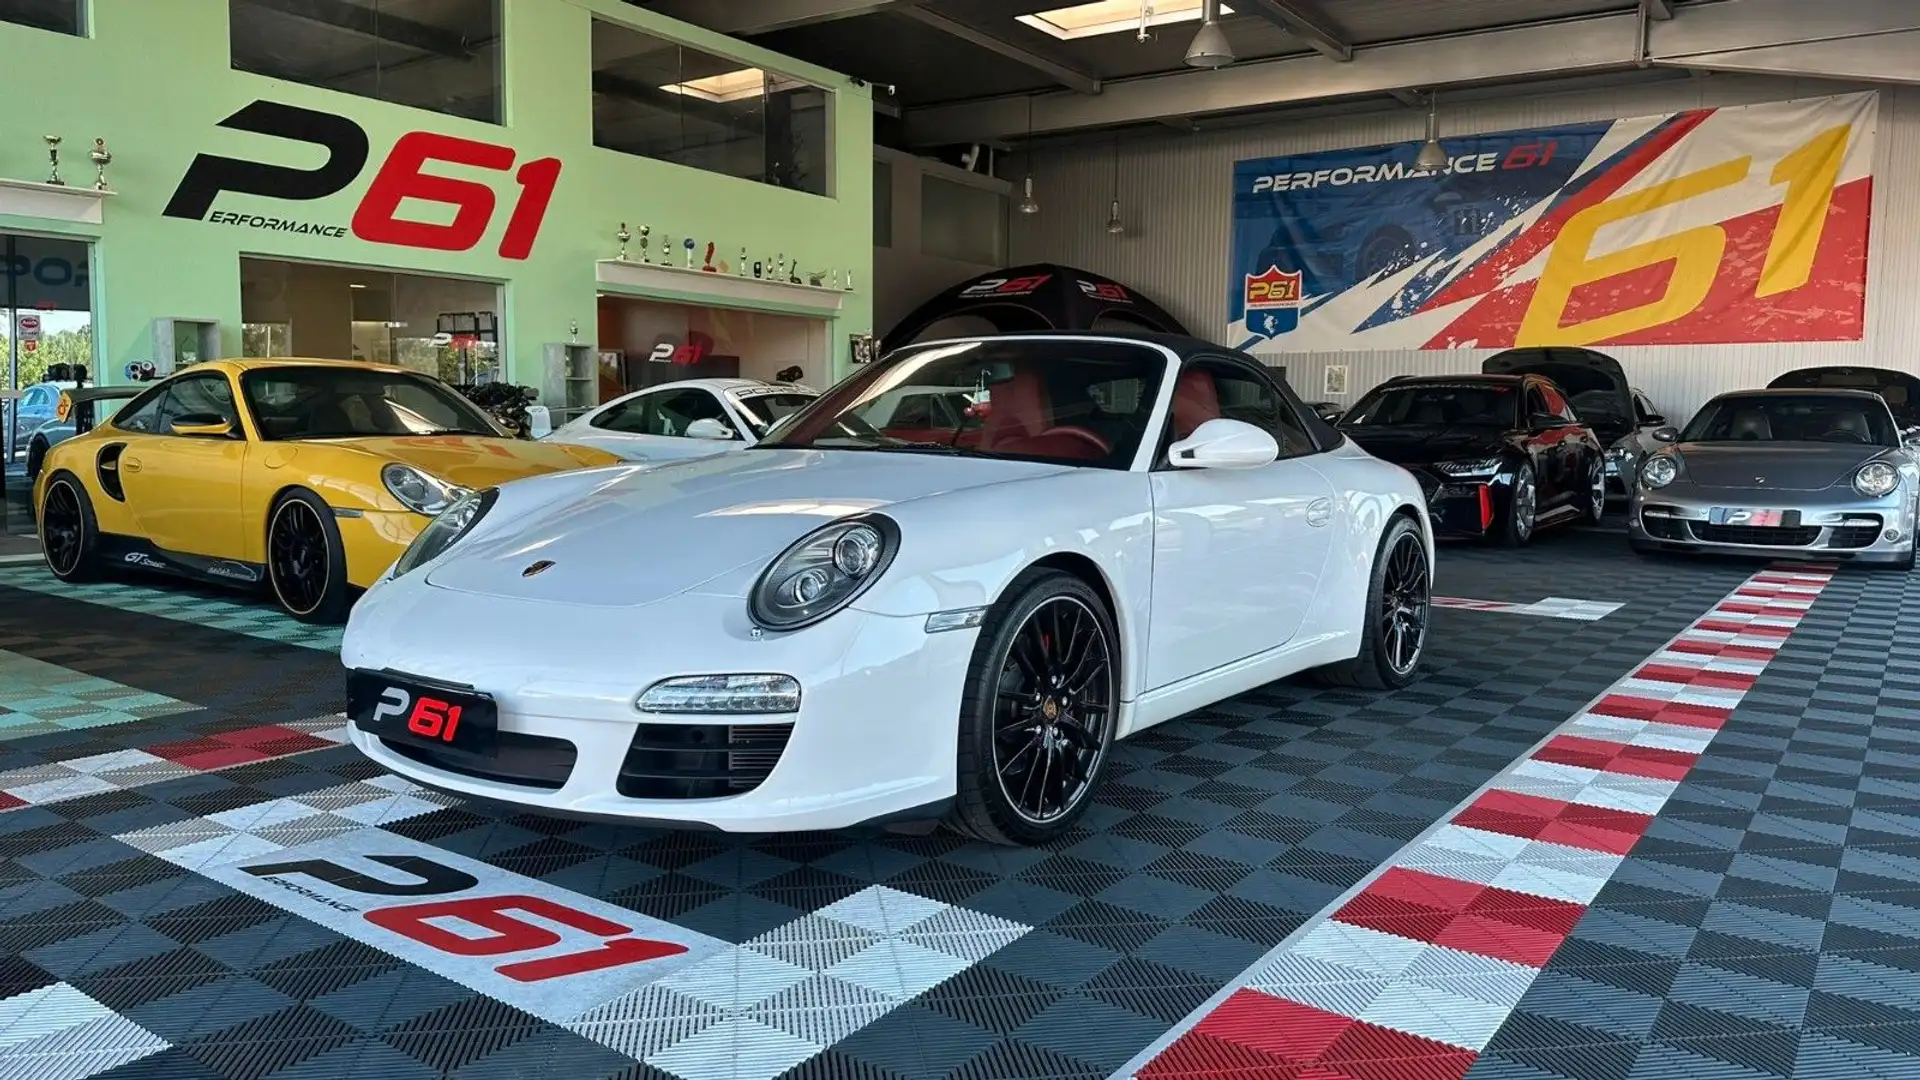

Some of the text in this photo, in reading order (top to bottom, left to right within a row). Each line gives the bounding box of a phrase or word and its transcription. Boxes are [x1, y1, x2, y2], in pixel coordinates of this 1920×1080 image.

[1502, 141, 1559, 169] 61
[162, 99, 562, 260] P61
[209, 210, 347, 238] ERFORMANCE
[1515, 124, 1851, 347] 61
[1249, 279, 1296, 299] P61
[649, 342, 702, 365] P61
[124, 551, 149, 563] GT
[372, 686, 463, 742] P61
[238, 854, 690, 983] P61
